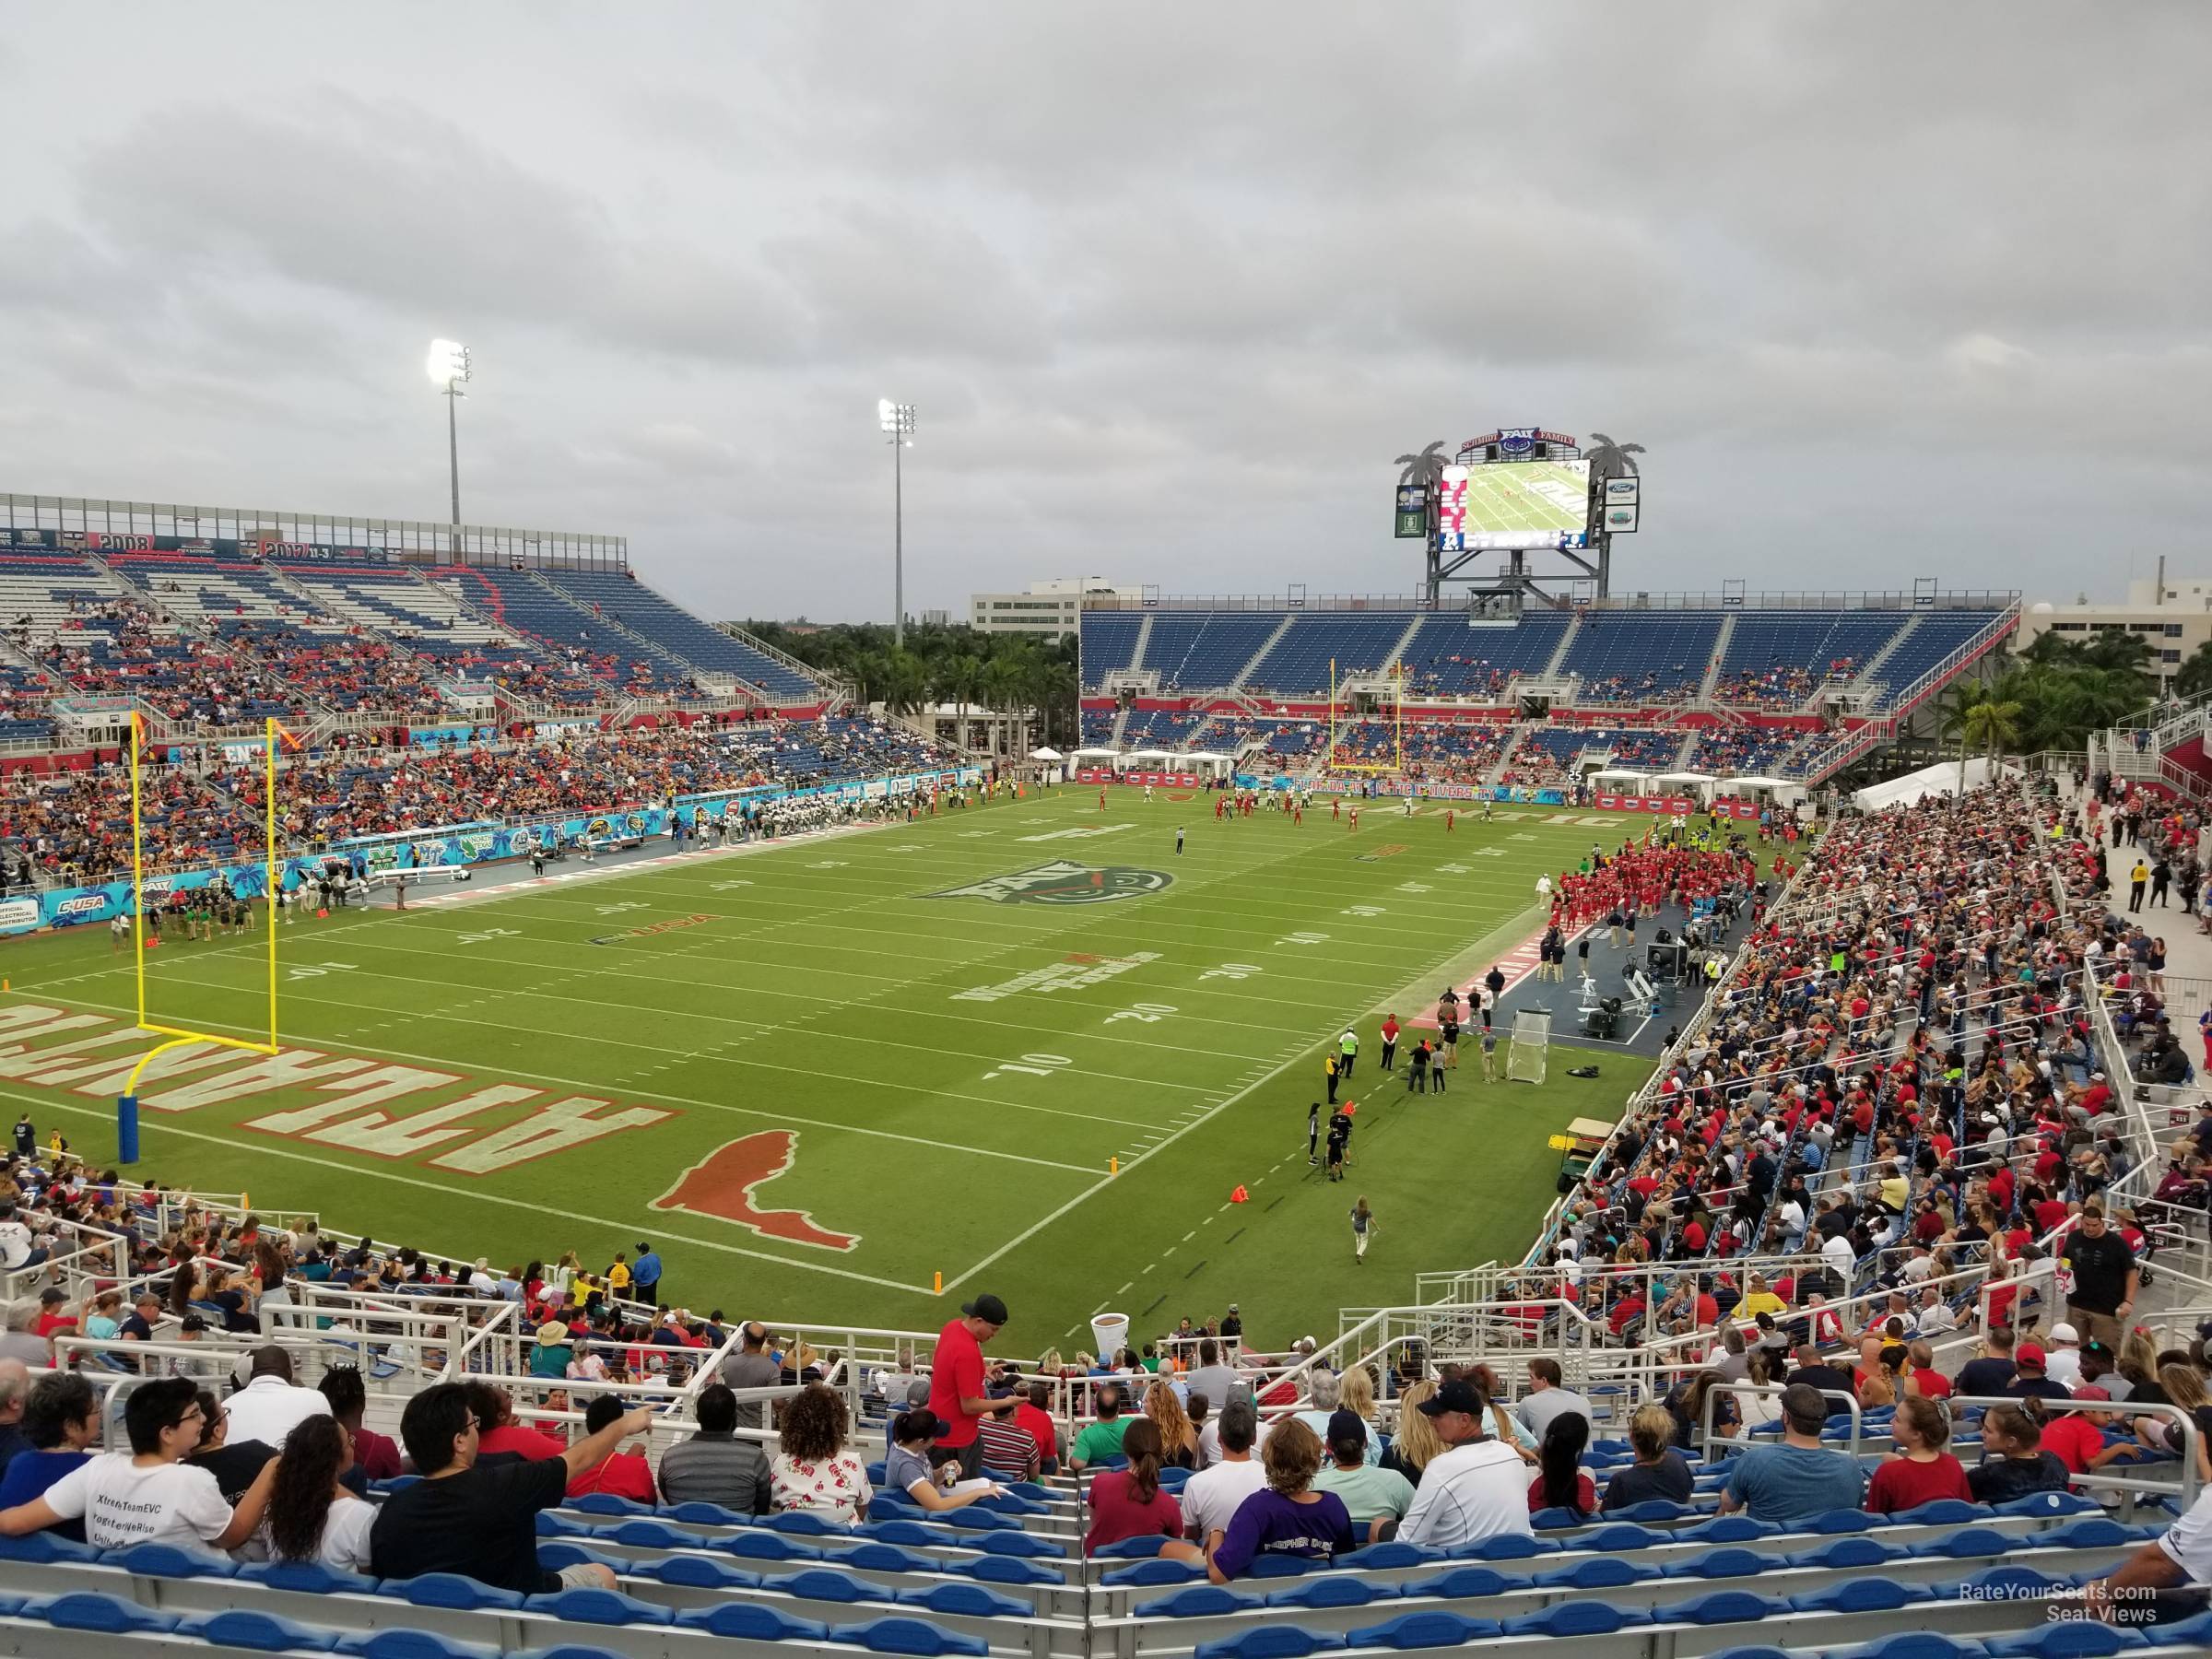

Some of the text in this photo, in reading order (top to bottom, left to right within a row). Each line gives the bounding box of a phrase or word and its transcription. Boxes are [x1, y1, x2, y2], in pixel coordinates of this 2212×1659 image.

[1462, 430, 1576, 450] SCHMIDT FAMILY
[1502, 429, 1533, 439] FAU
[100, 534, 149, 550] 2008
[265, 542, 305, 559] 2017
[310, 547, 330, 559] 11-3
[1568, 770, 1583, 781] 25
[1416, 784, 1495, 799] UNIVERSTY
[471, 833, 492, 842] NORTH
[473, 841, 492, 850] TEXAS
[1205, 963, 1264, 979] 30
[1112, 1002, 1179, 1023] 20
[997, 1053, 1073, 1077] 10
